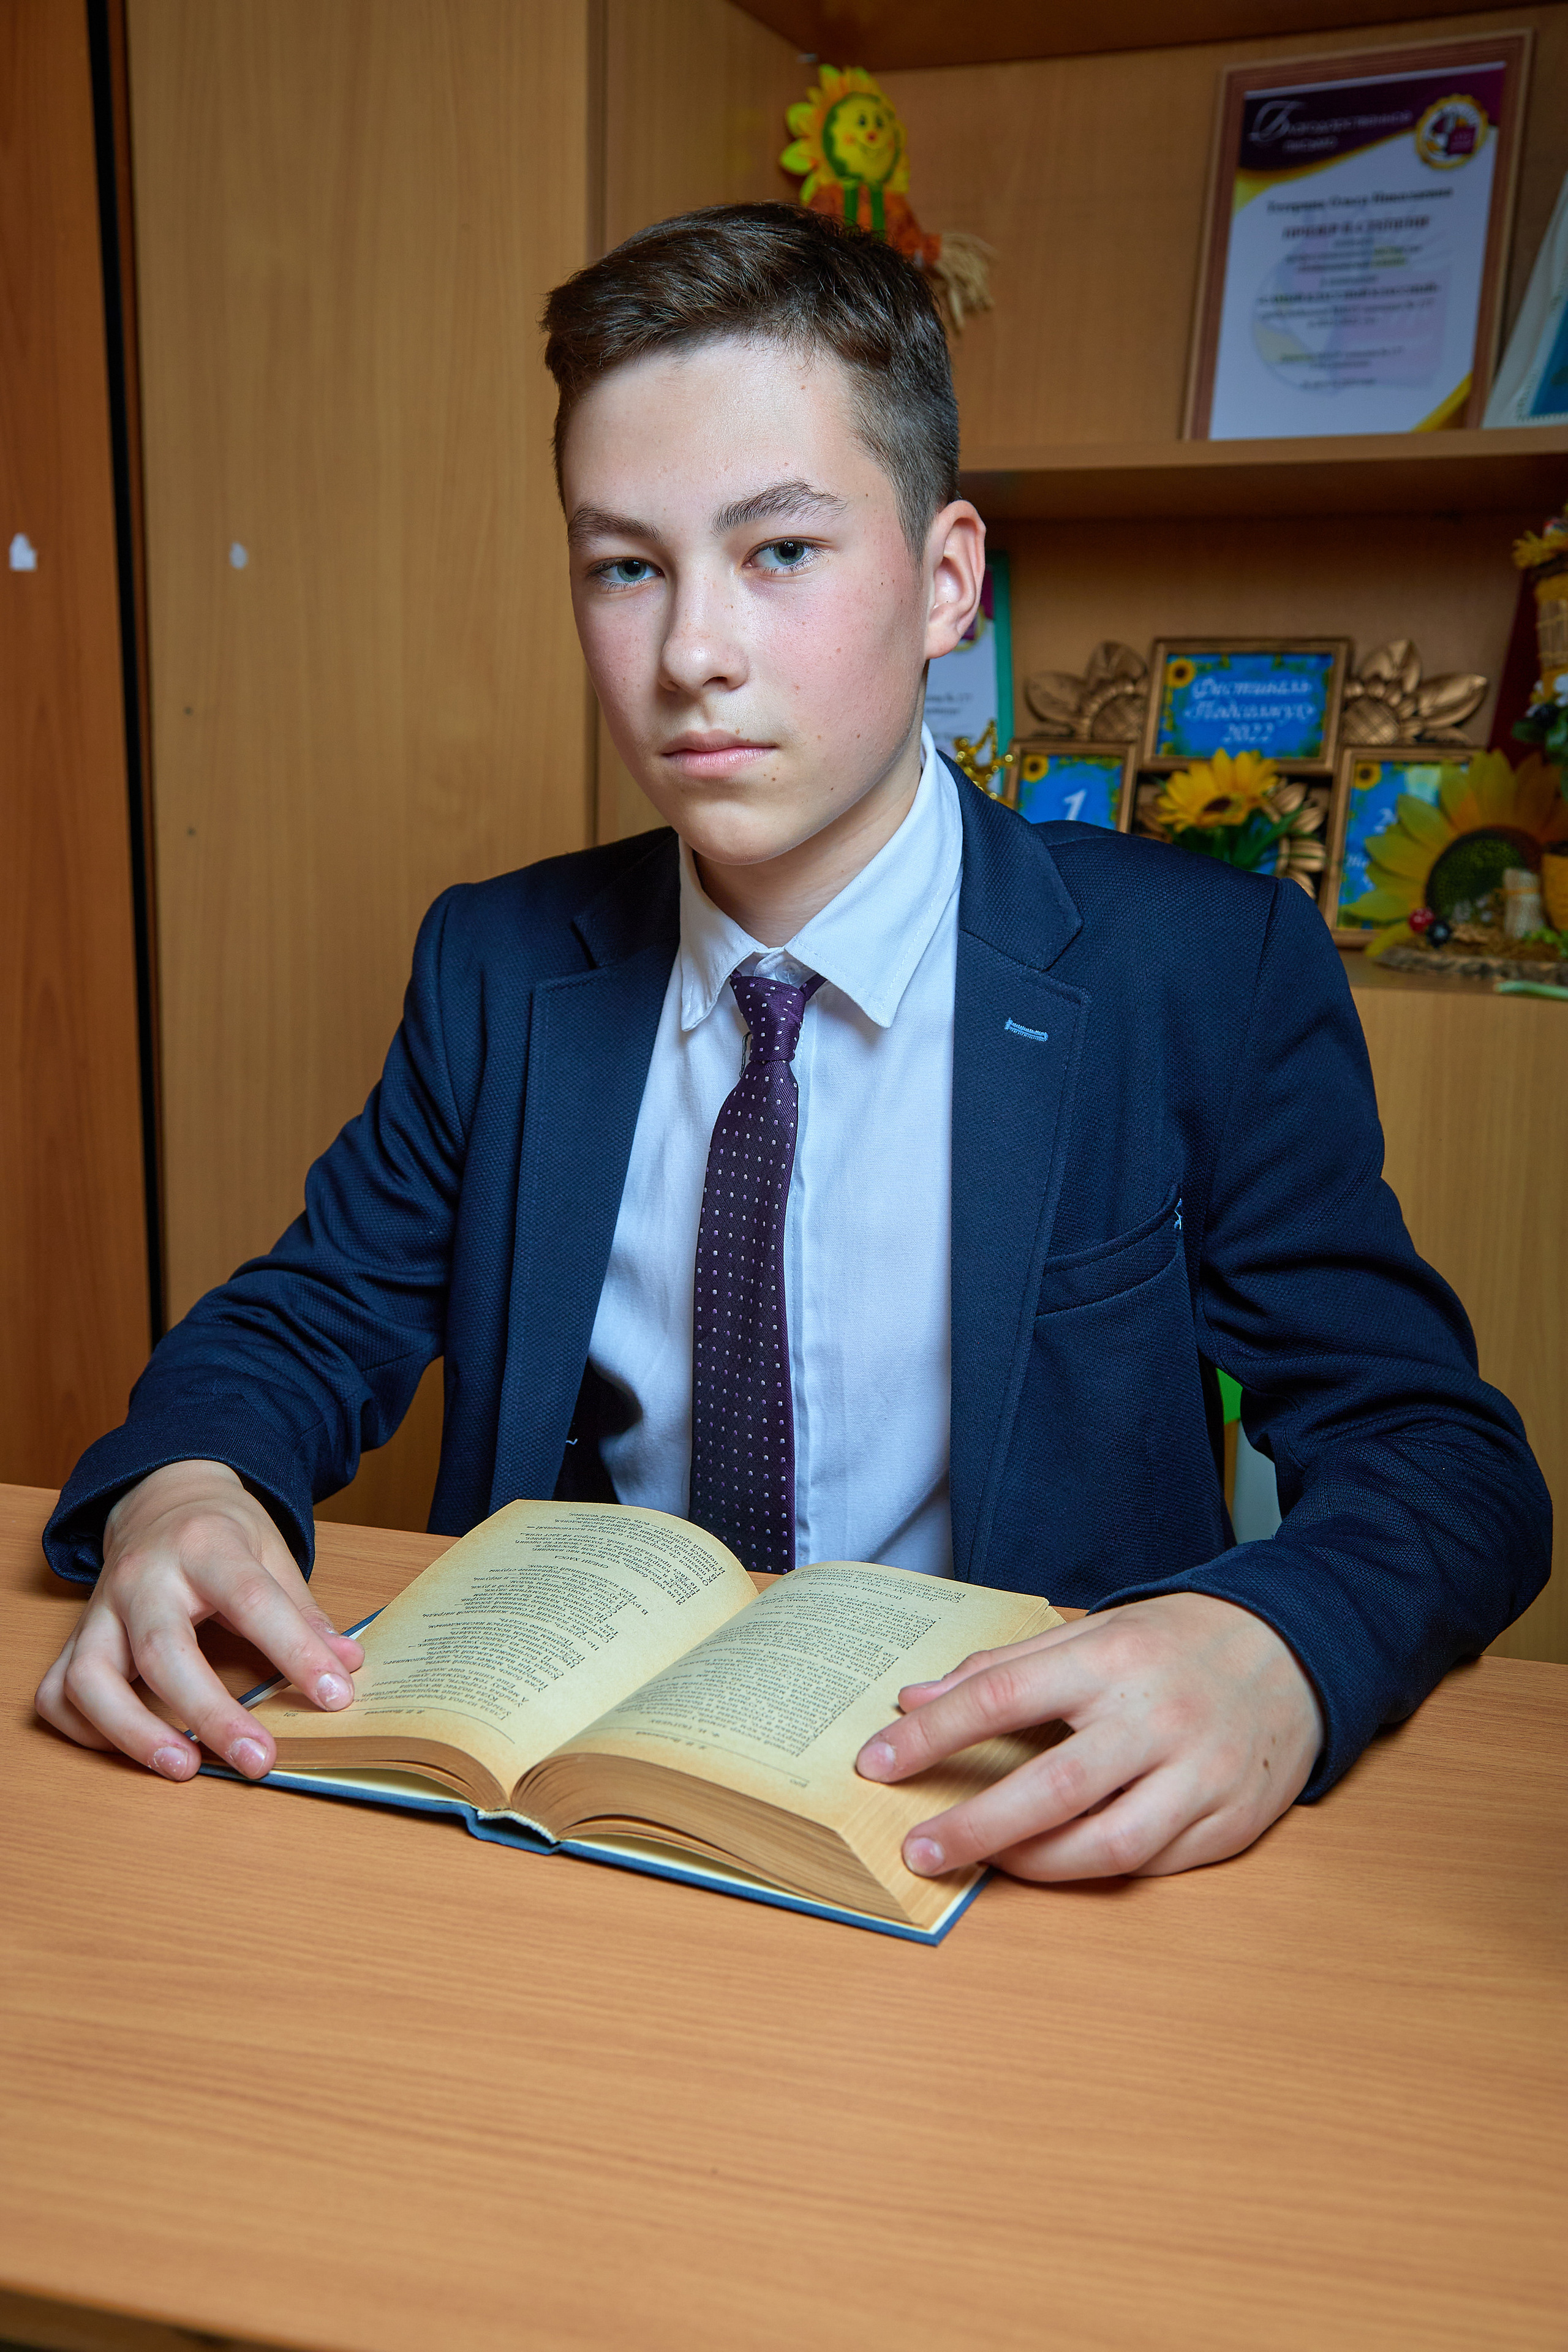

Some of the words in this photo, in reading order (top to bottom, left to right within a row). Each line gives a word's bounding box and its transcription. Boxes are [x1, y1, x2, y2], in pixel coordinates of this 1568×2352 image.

[1222, 722, 1275, 744] 2022
[1064, 788, 1087, 821] 1
[597, 1525, 628, 1534] гордый
[606, 1537, 627, 1547] зной,
[627, 1530, 662, 1545] утратил
[638, 1529, 675, 1545] роскоши
[580, 1550, 606, 1559] время
[597, 1550, 621, 1559] вновь
[660, 1542, 682, 1556] чутье
[580, 1558, 609, 1569] СРЕДИ
[633, 1546, 673, 1569] прохлады
[673, 1544, 712, 1573] мишурной
[621, 1557, 663, 1581] полюбишь
[623, 1562, 649, 1578] боюсь,
[682, 1555, 707, 1577] поэзии
[559, 1566, 620, 1589] надломленный
[672, 1568, 692, 1582] даст
[526, 1584, 567, 1596] скрипкой,
[649, 1577, 666, 1591] того
[662, 1580, 673, 1589] ты
[690, 1581, 701, 1594] Не
[508, 1588, 549, 1596] памятные
[620, 1587, 638, 1600] Или
[666, 1589, 676, 1599] не
[673, 1588, 687, 1604] Что
[530, 1599, 567, 1612] тщетные
[549, 1593, 595, 1613] пламенели
[566, 1592, 606, 1612] разбитой
[535, 1610, 570, 1626] жалкий
[569, 1610, 598, 1627] гаснет,
[595, 1611, 608, 1622] Ни
[482, 1630, 519, 1641] радости
[485, 1621, 539, 1636] насладиться
[529, 1624, 575, 1647] Последнее
[570, 1624, 588, 1636] Как
[598, 1626, 615, 1641] Иль
[469, 1635, 510, 1644] радостей
[459, 1649, 494, 1658] каждой
[488, 1647, 521, 1660] свежие
[517, 1637, 576, 1670] Неслыханные
[520, 1645, 543, 1656] мнит
[539, 1633, 586, 1662] Последним
[451, 1659, 496, 1671] чарующей
[474, 1656, 504, 1667] может
[494, 1654, 516, 1665] виде
[498, 1668, 524, 1681] боясь
[517, 1662, 537, 1675] При
[521, 1657, 560, 1681] Когда-то
[506, 1663, 549, 1689] Невольно,
[524, 1679, 541, 1694] Уже
